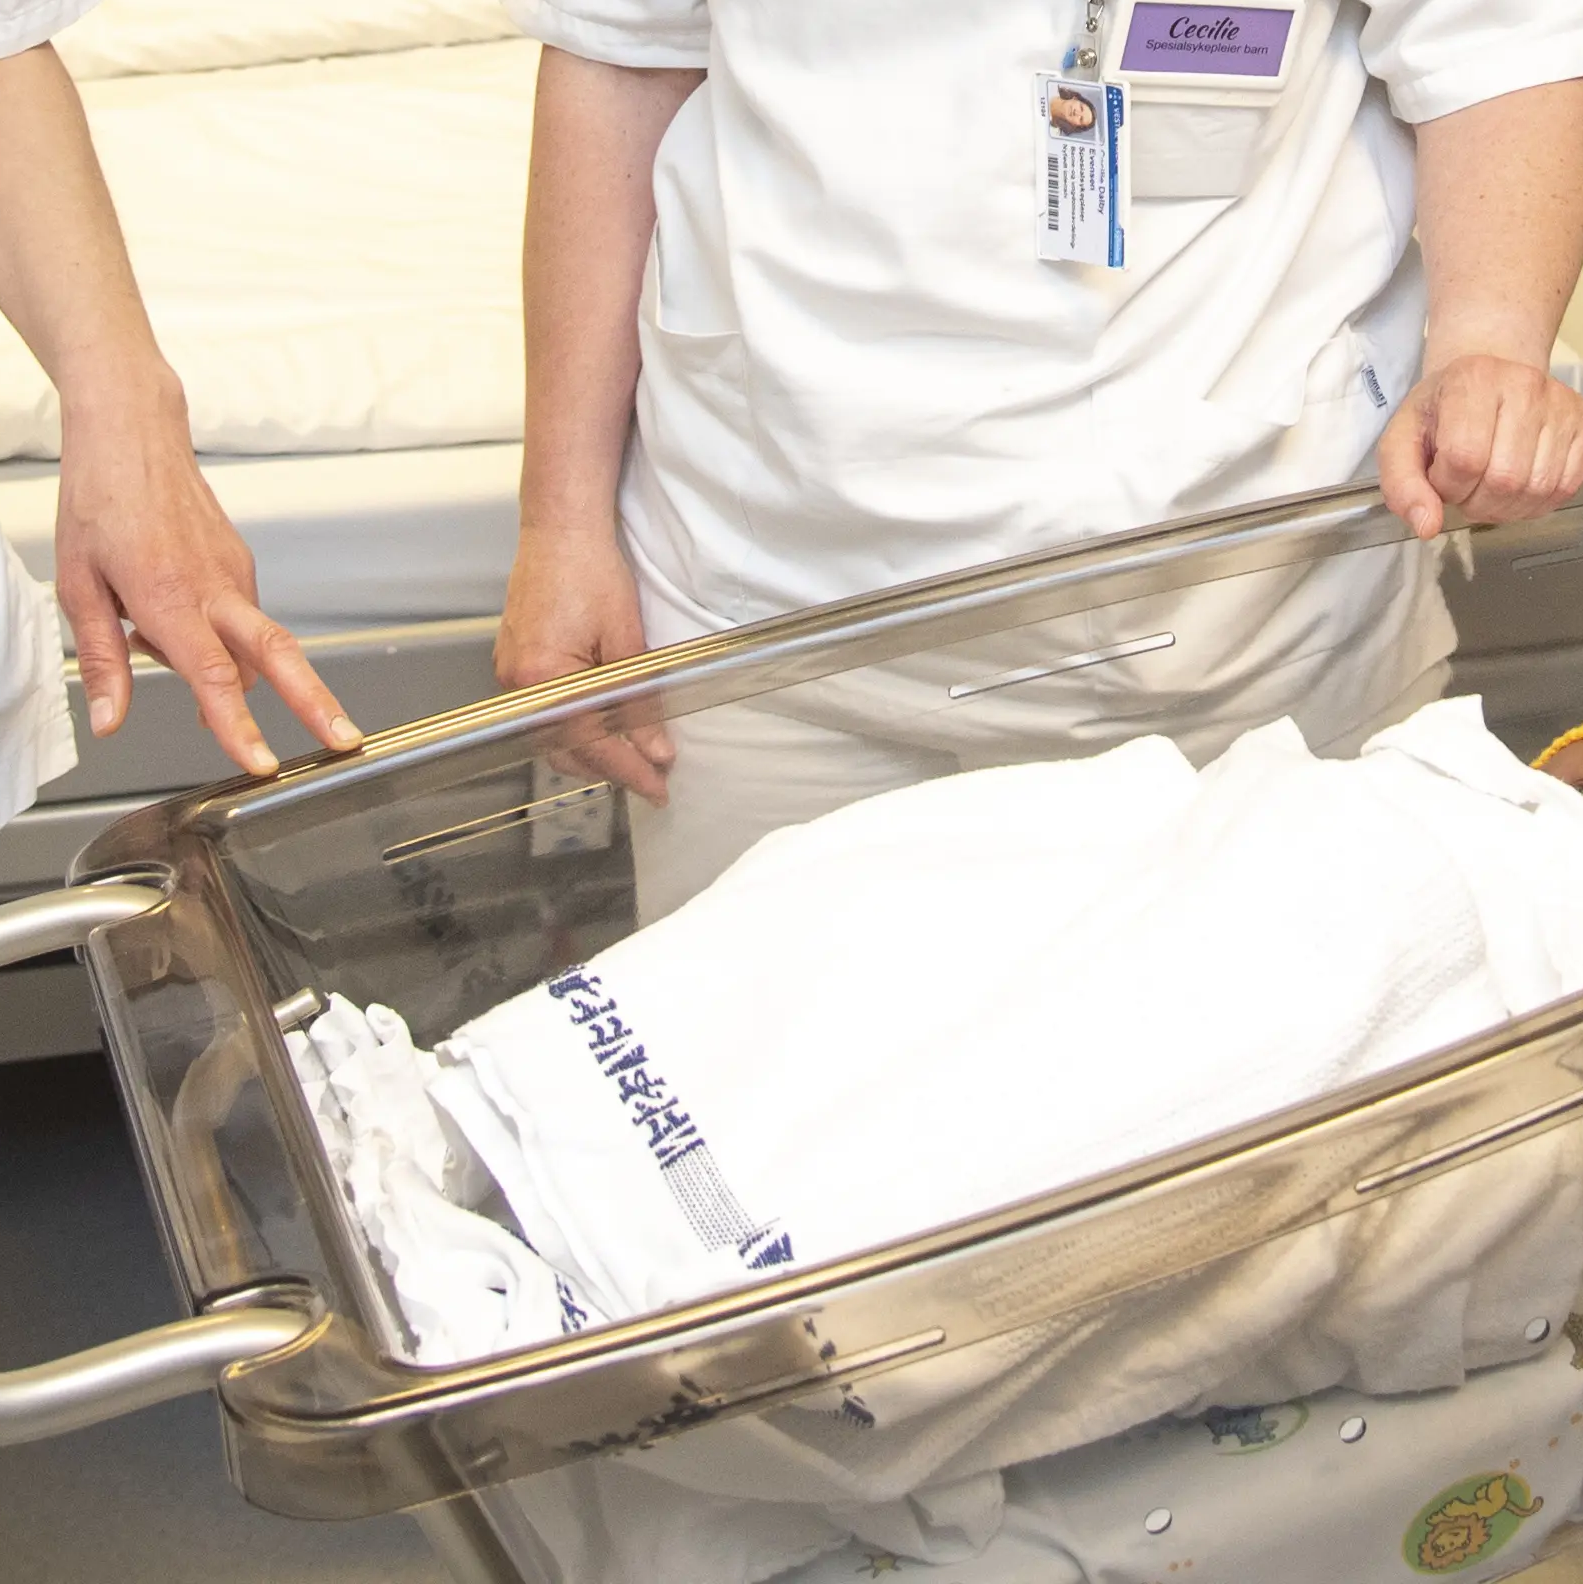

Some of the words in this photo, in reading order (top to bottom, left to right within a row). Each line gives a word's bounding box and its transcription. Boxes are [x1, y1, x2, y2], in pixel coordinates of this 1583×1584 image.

[1169, 16, 1240, 41] Cecilie
[1145, 39, 1242, 54] Spesialsykepleier
[1243, 43, 1269, 55] barn
[1097, 187, 1106, 215] Dalby
